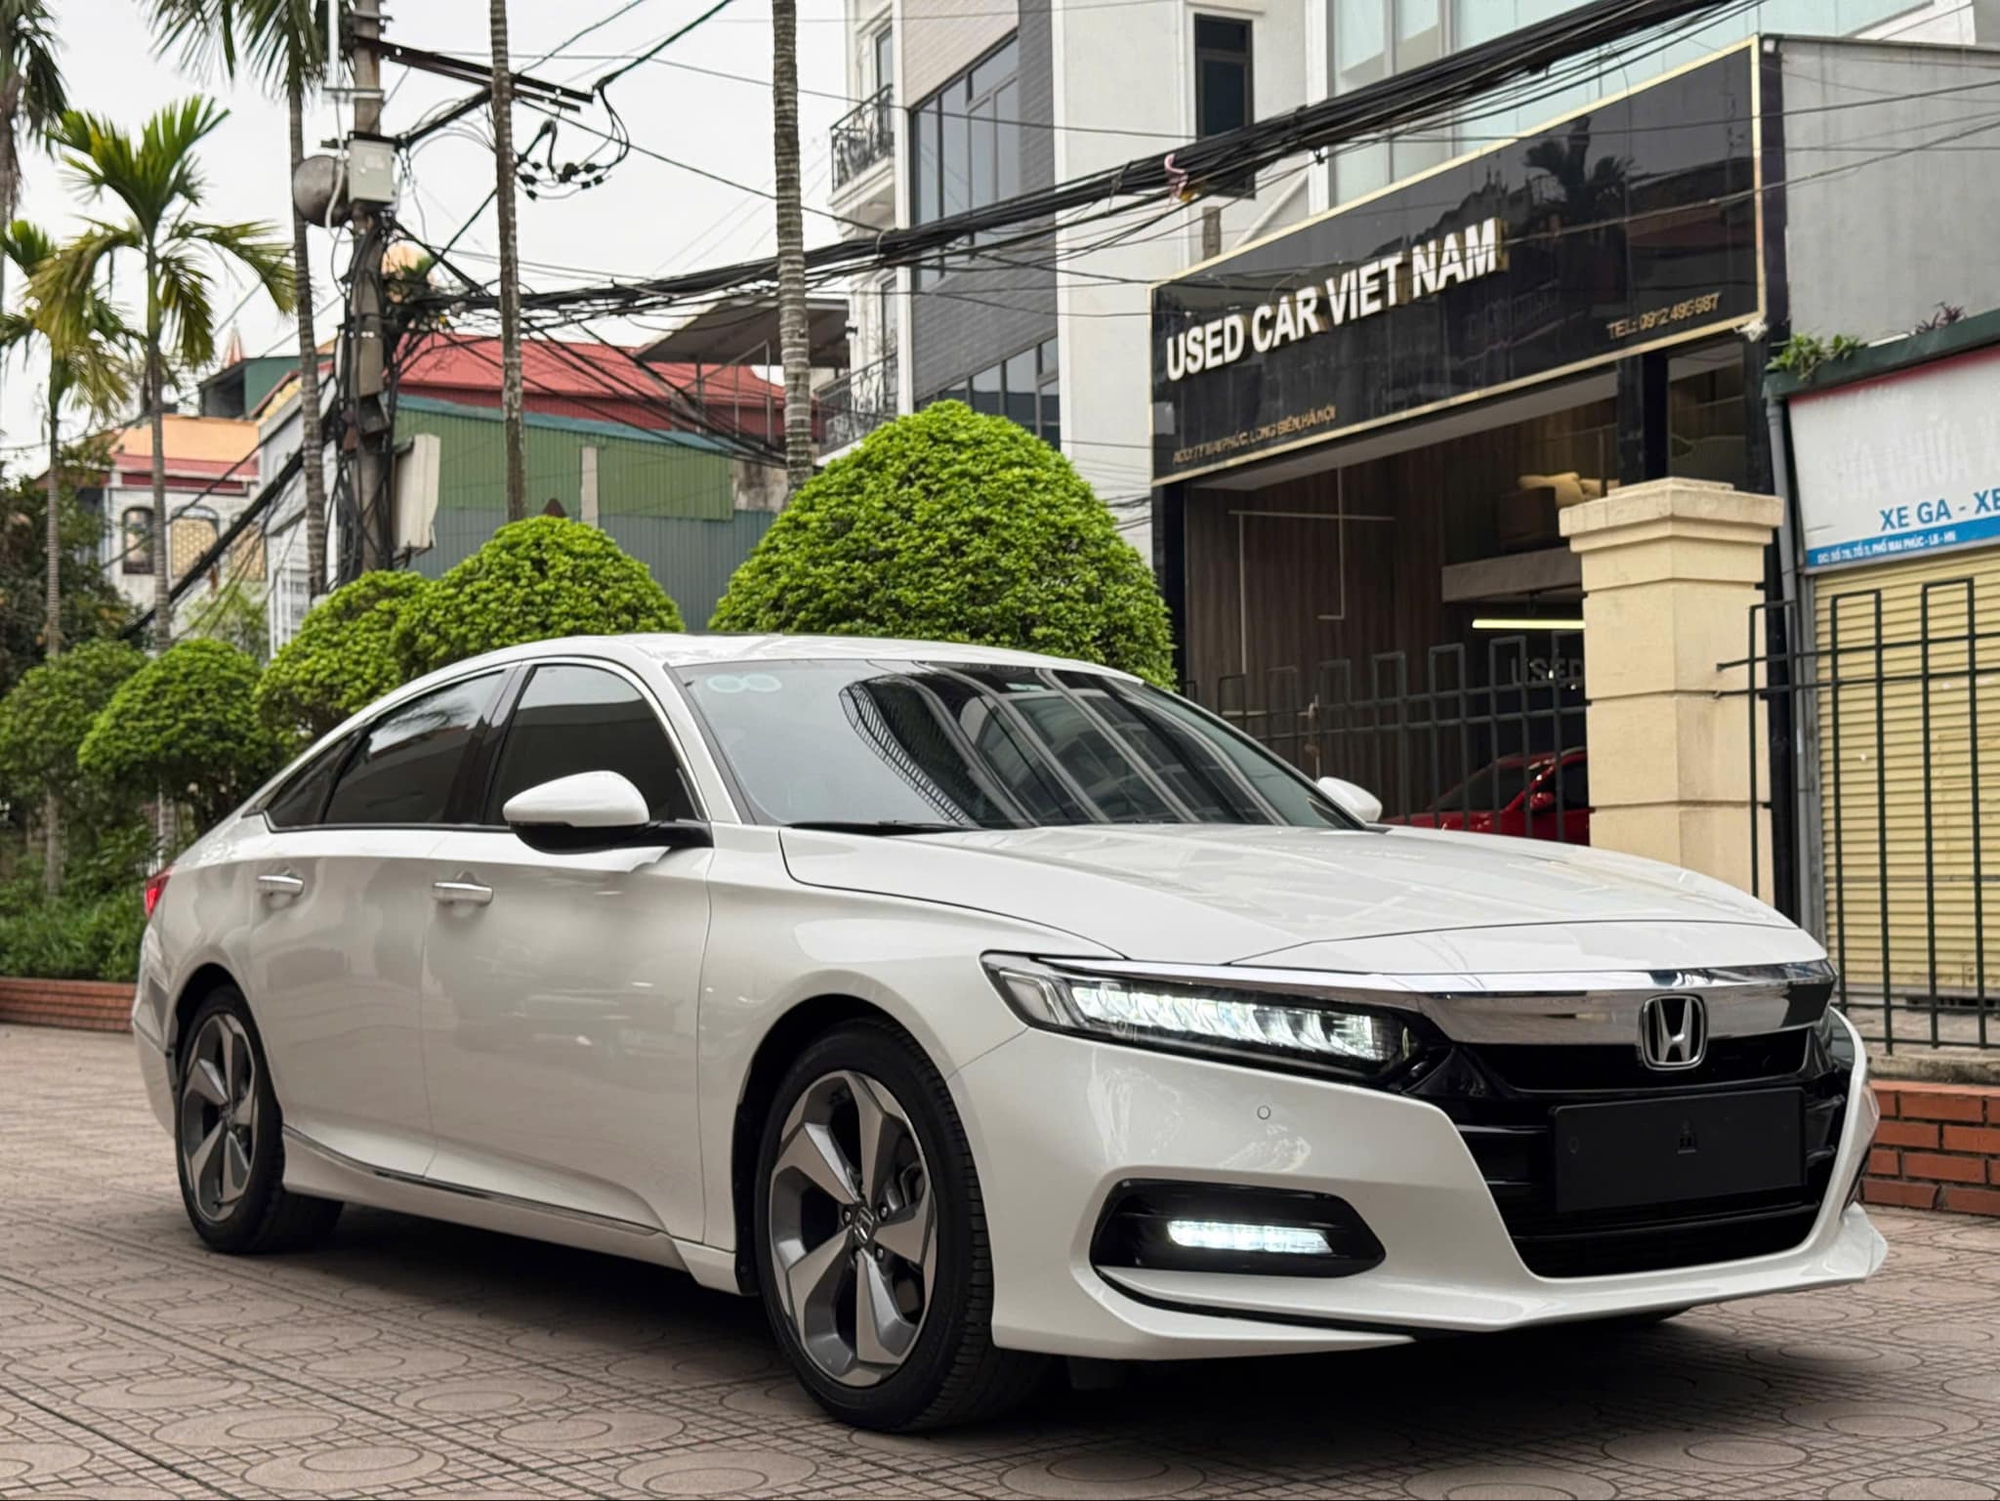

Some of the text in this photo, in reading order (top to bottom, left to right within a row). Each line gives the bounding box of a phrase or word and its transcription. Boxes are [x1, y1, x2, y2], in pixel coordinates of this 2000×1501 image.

[1167, 217, 1503, 381] USED CAR VIET NAM
[1880, 505, 1910, 532] XE
[1916, 498, 1953, 525] GA
